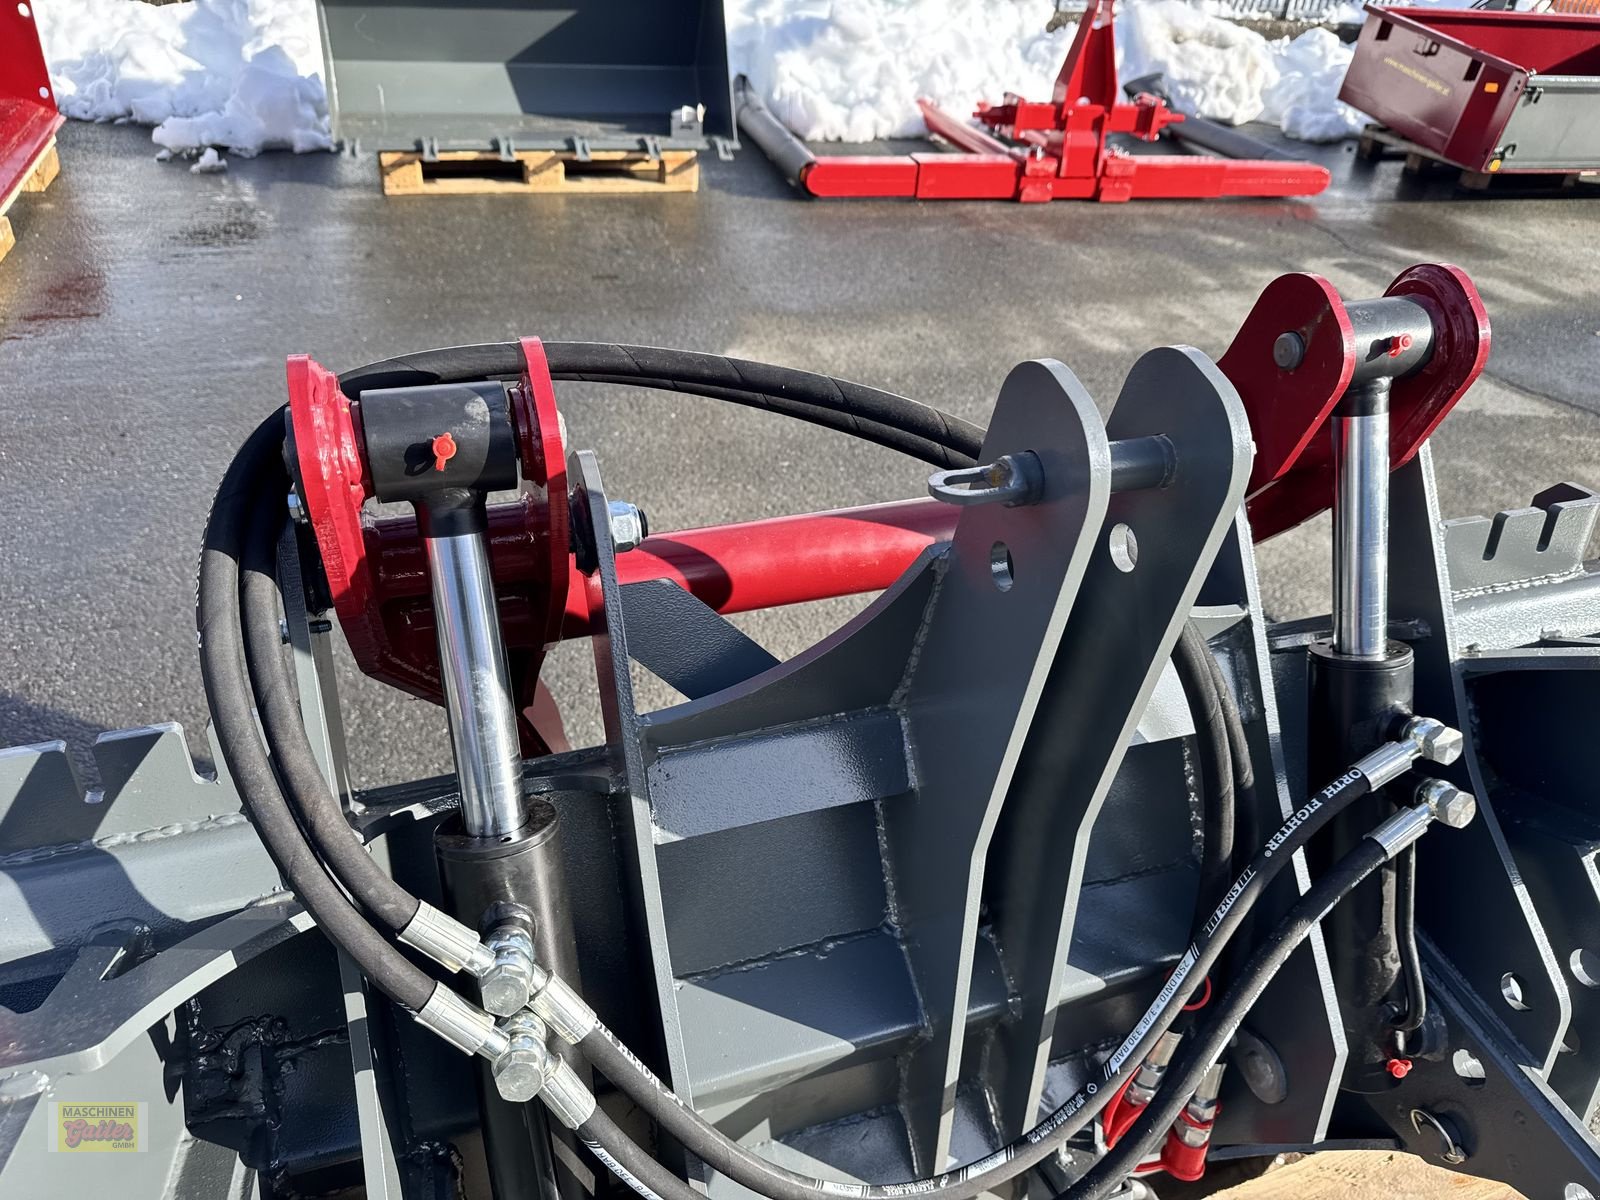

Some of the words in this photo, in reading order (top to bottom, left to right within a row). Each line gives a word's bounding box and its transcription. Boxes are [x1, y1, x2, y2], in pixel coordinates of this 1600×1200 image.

[1217, 886, 1239, 914] SNX2
[1173, 959, 1190, 979] 2SN
[1158, 978, 1177, 1002] DN10
[1126, 1028, 1142, 1045] 330
[1112, 1044, 1131, 1063] BAR
